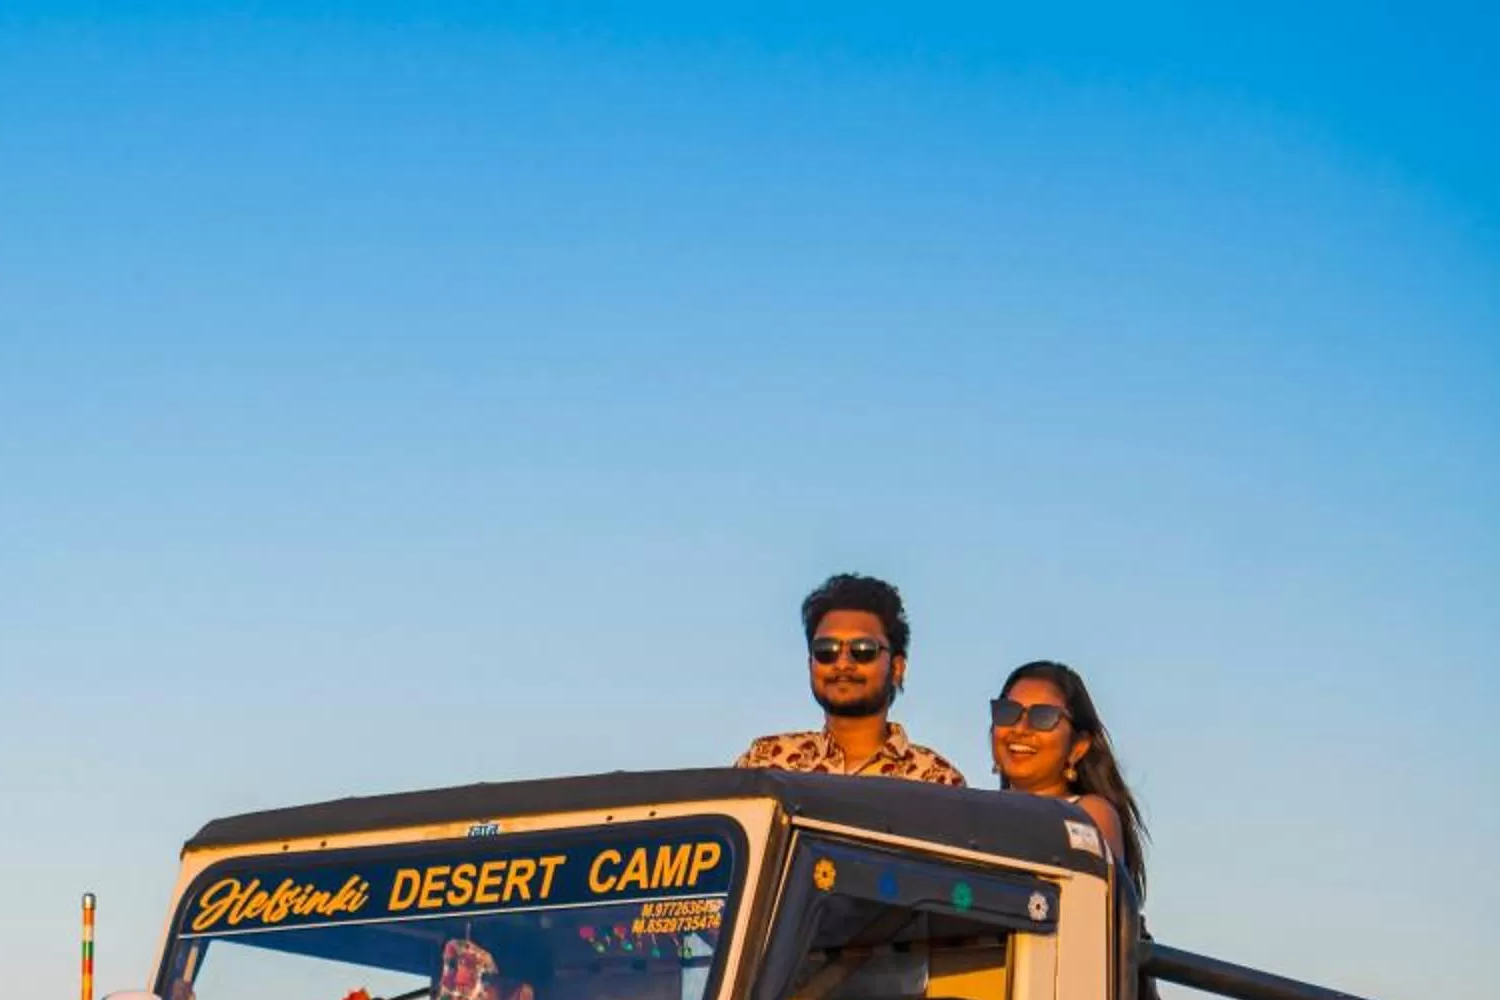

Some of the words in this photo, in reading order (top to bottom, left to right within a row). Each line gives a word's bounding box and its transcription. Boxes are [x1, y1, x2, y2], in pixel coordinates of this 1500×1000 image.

[192, 874, 369, 932] Helsinki
[388, 855, 566, 910] DESERT
[588, 841, 722, 893] CAMP
